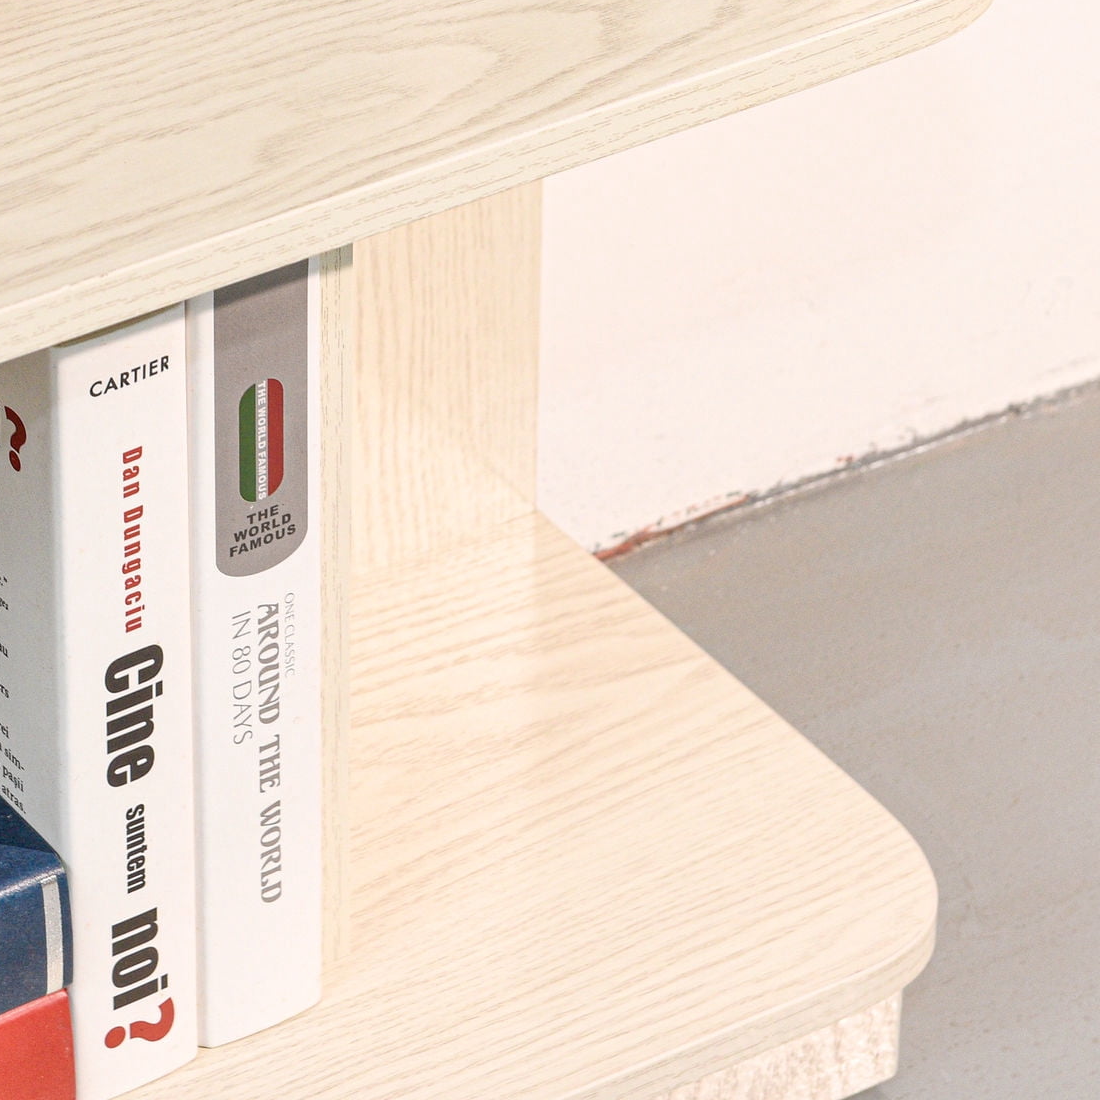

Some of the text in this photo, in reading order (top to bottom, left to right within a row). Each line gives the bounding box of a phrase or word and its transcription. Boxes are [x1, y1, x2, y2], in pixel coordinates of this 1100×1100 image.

[89, 355, 170, 397] CARTIER
[256, 381, 268, 500] THE WORLD FAMOUS
[122, 446, 144, 634] Dan Dungaciu
[229, 523, 296, 557] FAMOUS
[234, 513, 292, 543] WORLD
[247, 504, 279, 525] THE
[231, 610, 254, 746] IN 80 DAYS
[284, 592, 296, 678] ONE CLASSIC
[257, 603, 283, 904] AROUND THE WORLD
[104, 643, 175, 1049] Cine suntem noi?
